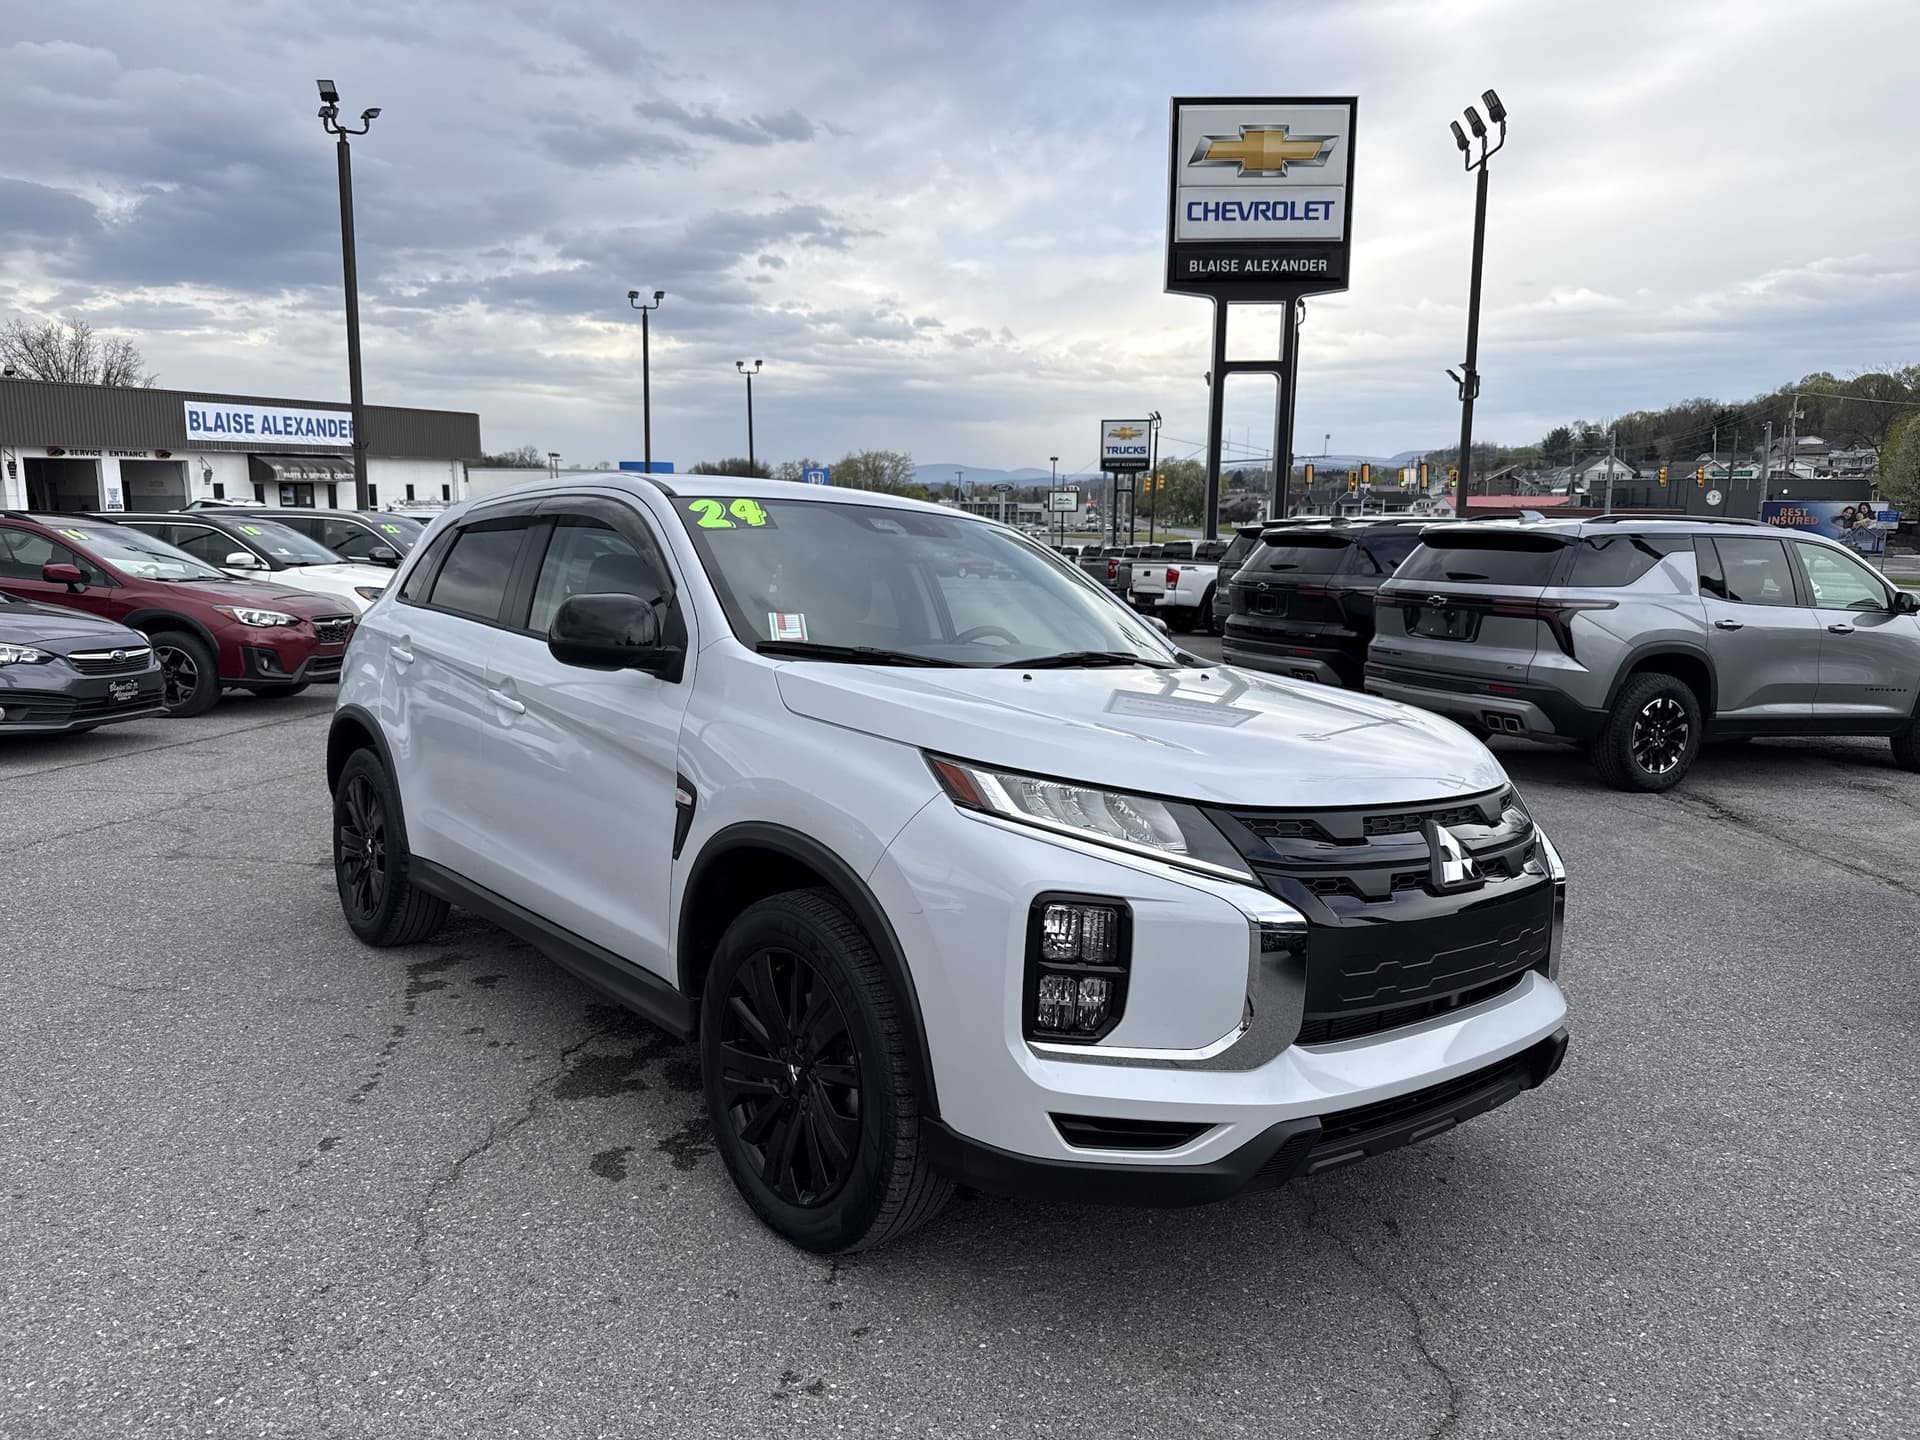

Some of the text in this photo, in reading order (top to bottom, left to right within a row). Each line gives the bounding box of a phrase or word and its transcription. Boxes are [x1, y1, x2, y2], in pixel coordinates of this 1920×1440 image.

[1187, 200, 1336, 222] CHEVROLET
[1189, 259, 1328, 273] BLAISE ALEXANDER
[188, 410, 255, 434] BLAISE
[69, 449, 148, 458] SERVICE ENTRANCE
[1106, 446, 1147, 455] TRUCKS
[283, 472, 301, 480] PARTS
[688, 499, 767, 528] 24
[1780, 507, 1808, 517] REST
[1768, 516, 1819, 526] INSURED
